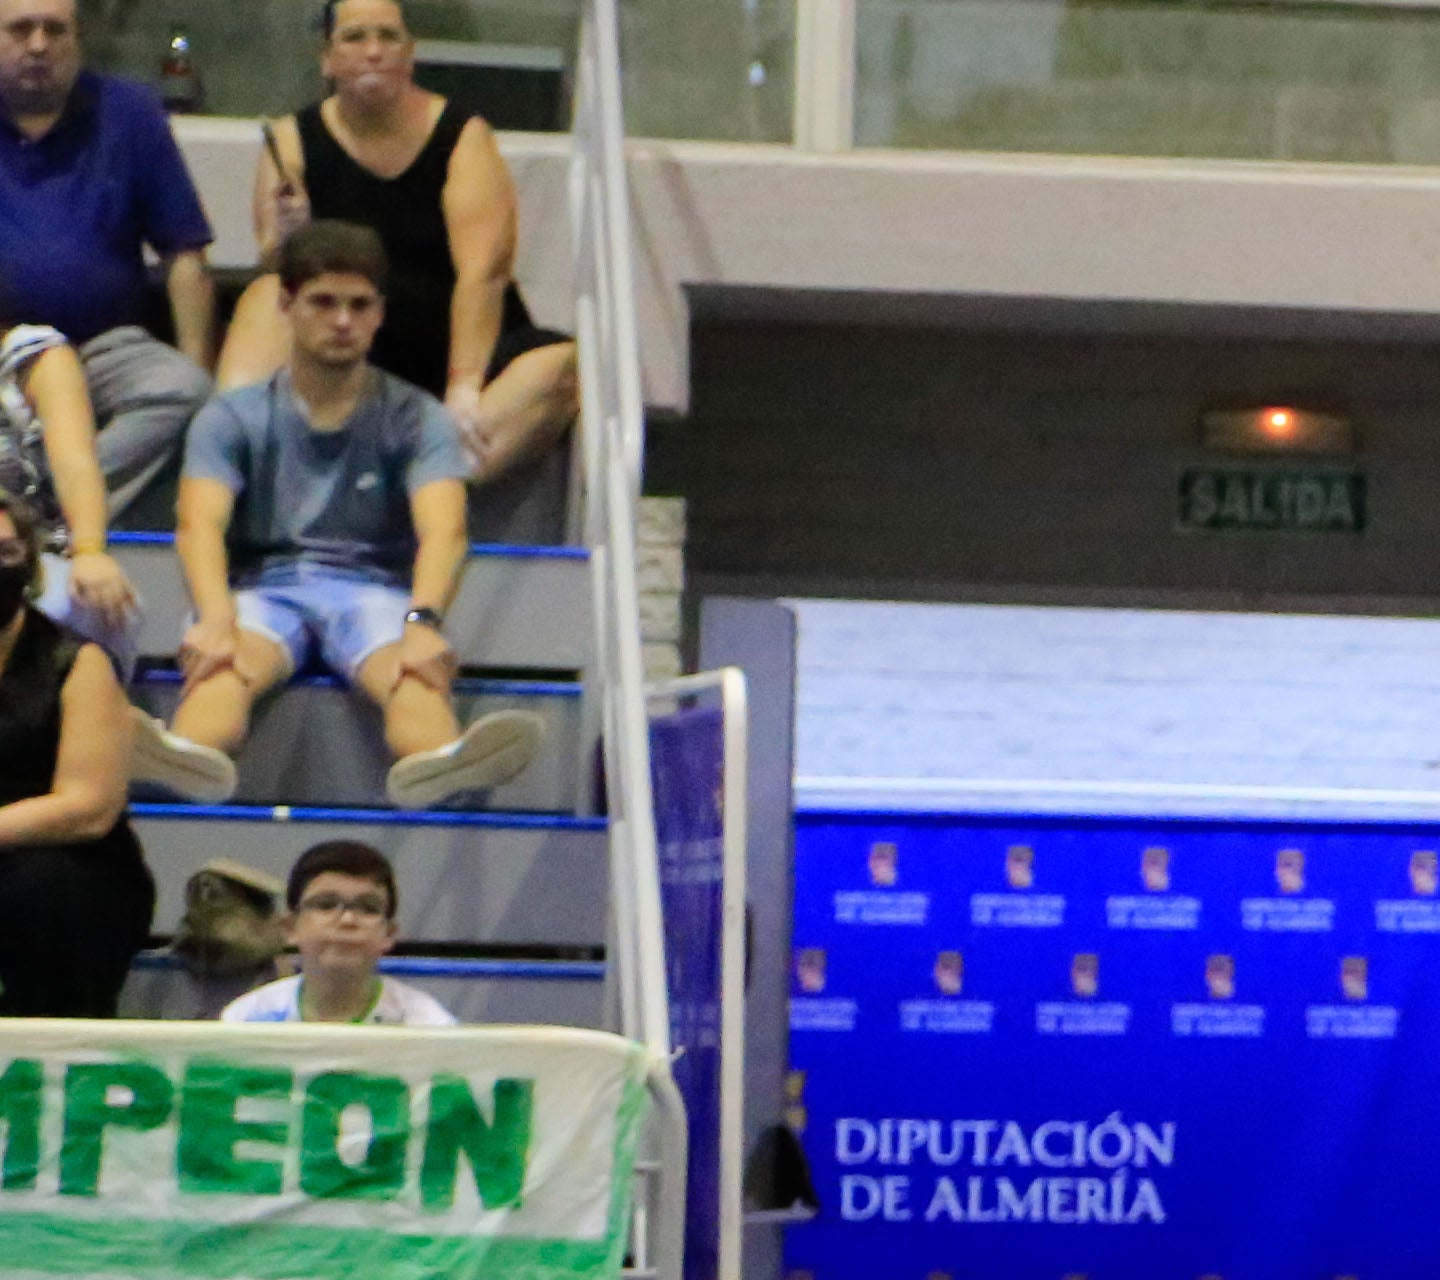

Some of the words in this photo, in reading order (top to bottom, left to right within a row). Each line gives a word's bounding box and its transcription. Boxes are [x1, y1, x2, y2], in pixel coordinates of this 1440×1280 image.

[1192, 476, 1354, 524] SALIDA
[835, 1110, 1177, 1168] DIPUTACIÓN
[840, 1174, 913, 1221] DE
[924, 1167, 1167, 1224] ALMERÍA
